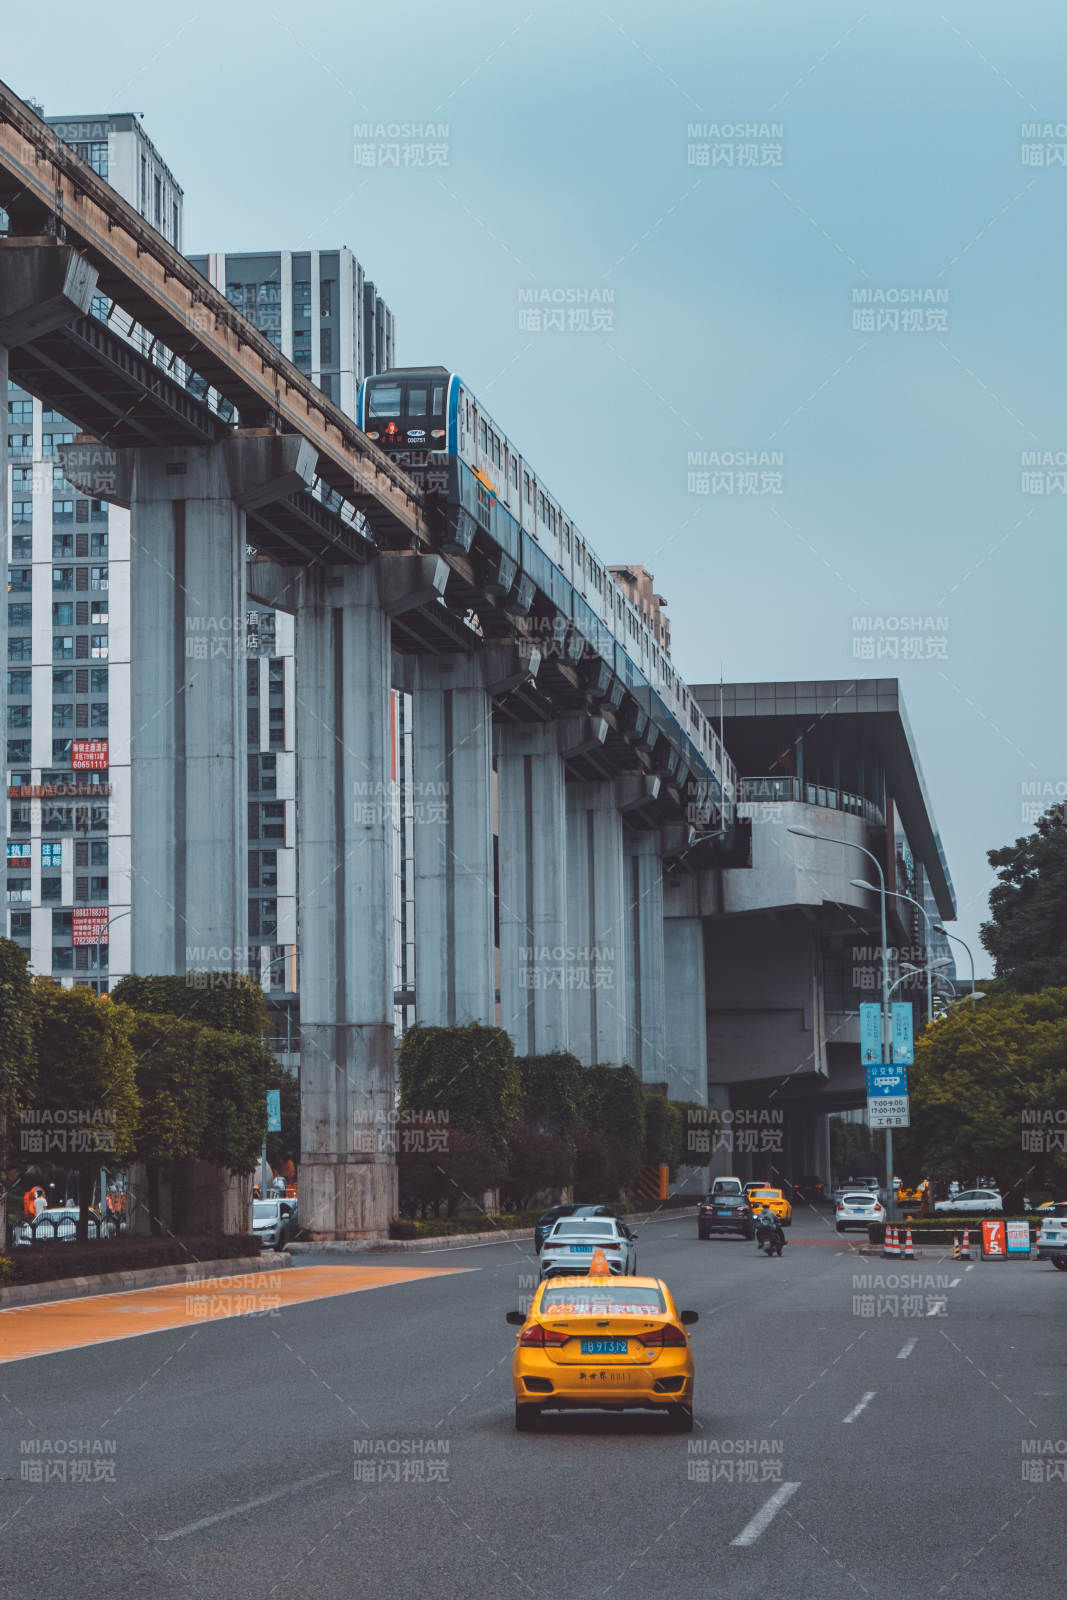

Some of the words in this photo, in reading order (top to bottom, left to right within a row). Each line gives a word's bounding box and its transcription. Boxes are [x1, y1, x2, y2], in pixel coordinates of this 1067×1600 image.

[247, 610, 259, 648] 酒店
[42, 843, 61, 855] 注册
[42, 855, 61, 866] 商标
[871, 1066, 903, 1076] 公交专用
[877, 1117, 902, 1125] 工作日
[987, 1225, 1000, 1240] 7
[990, 1242, 999, 1252] 5
[579, 1370, 605, 1381] 新世界
